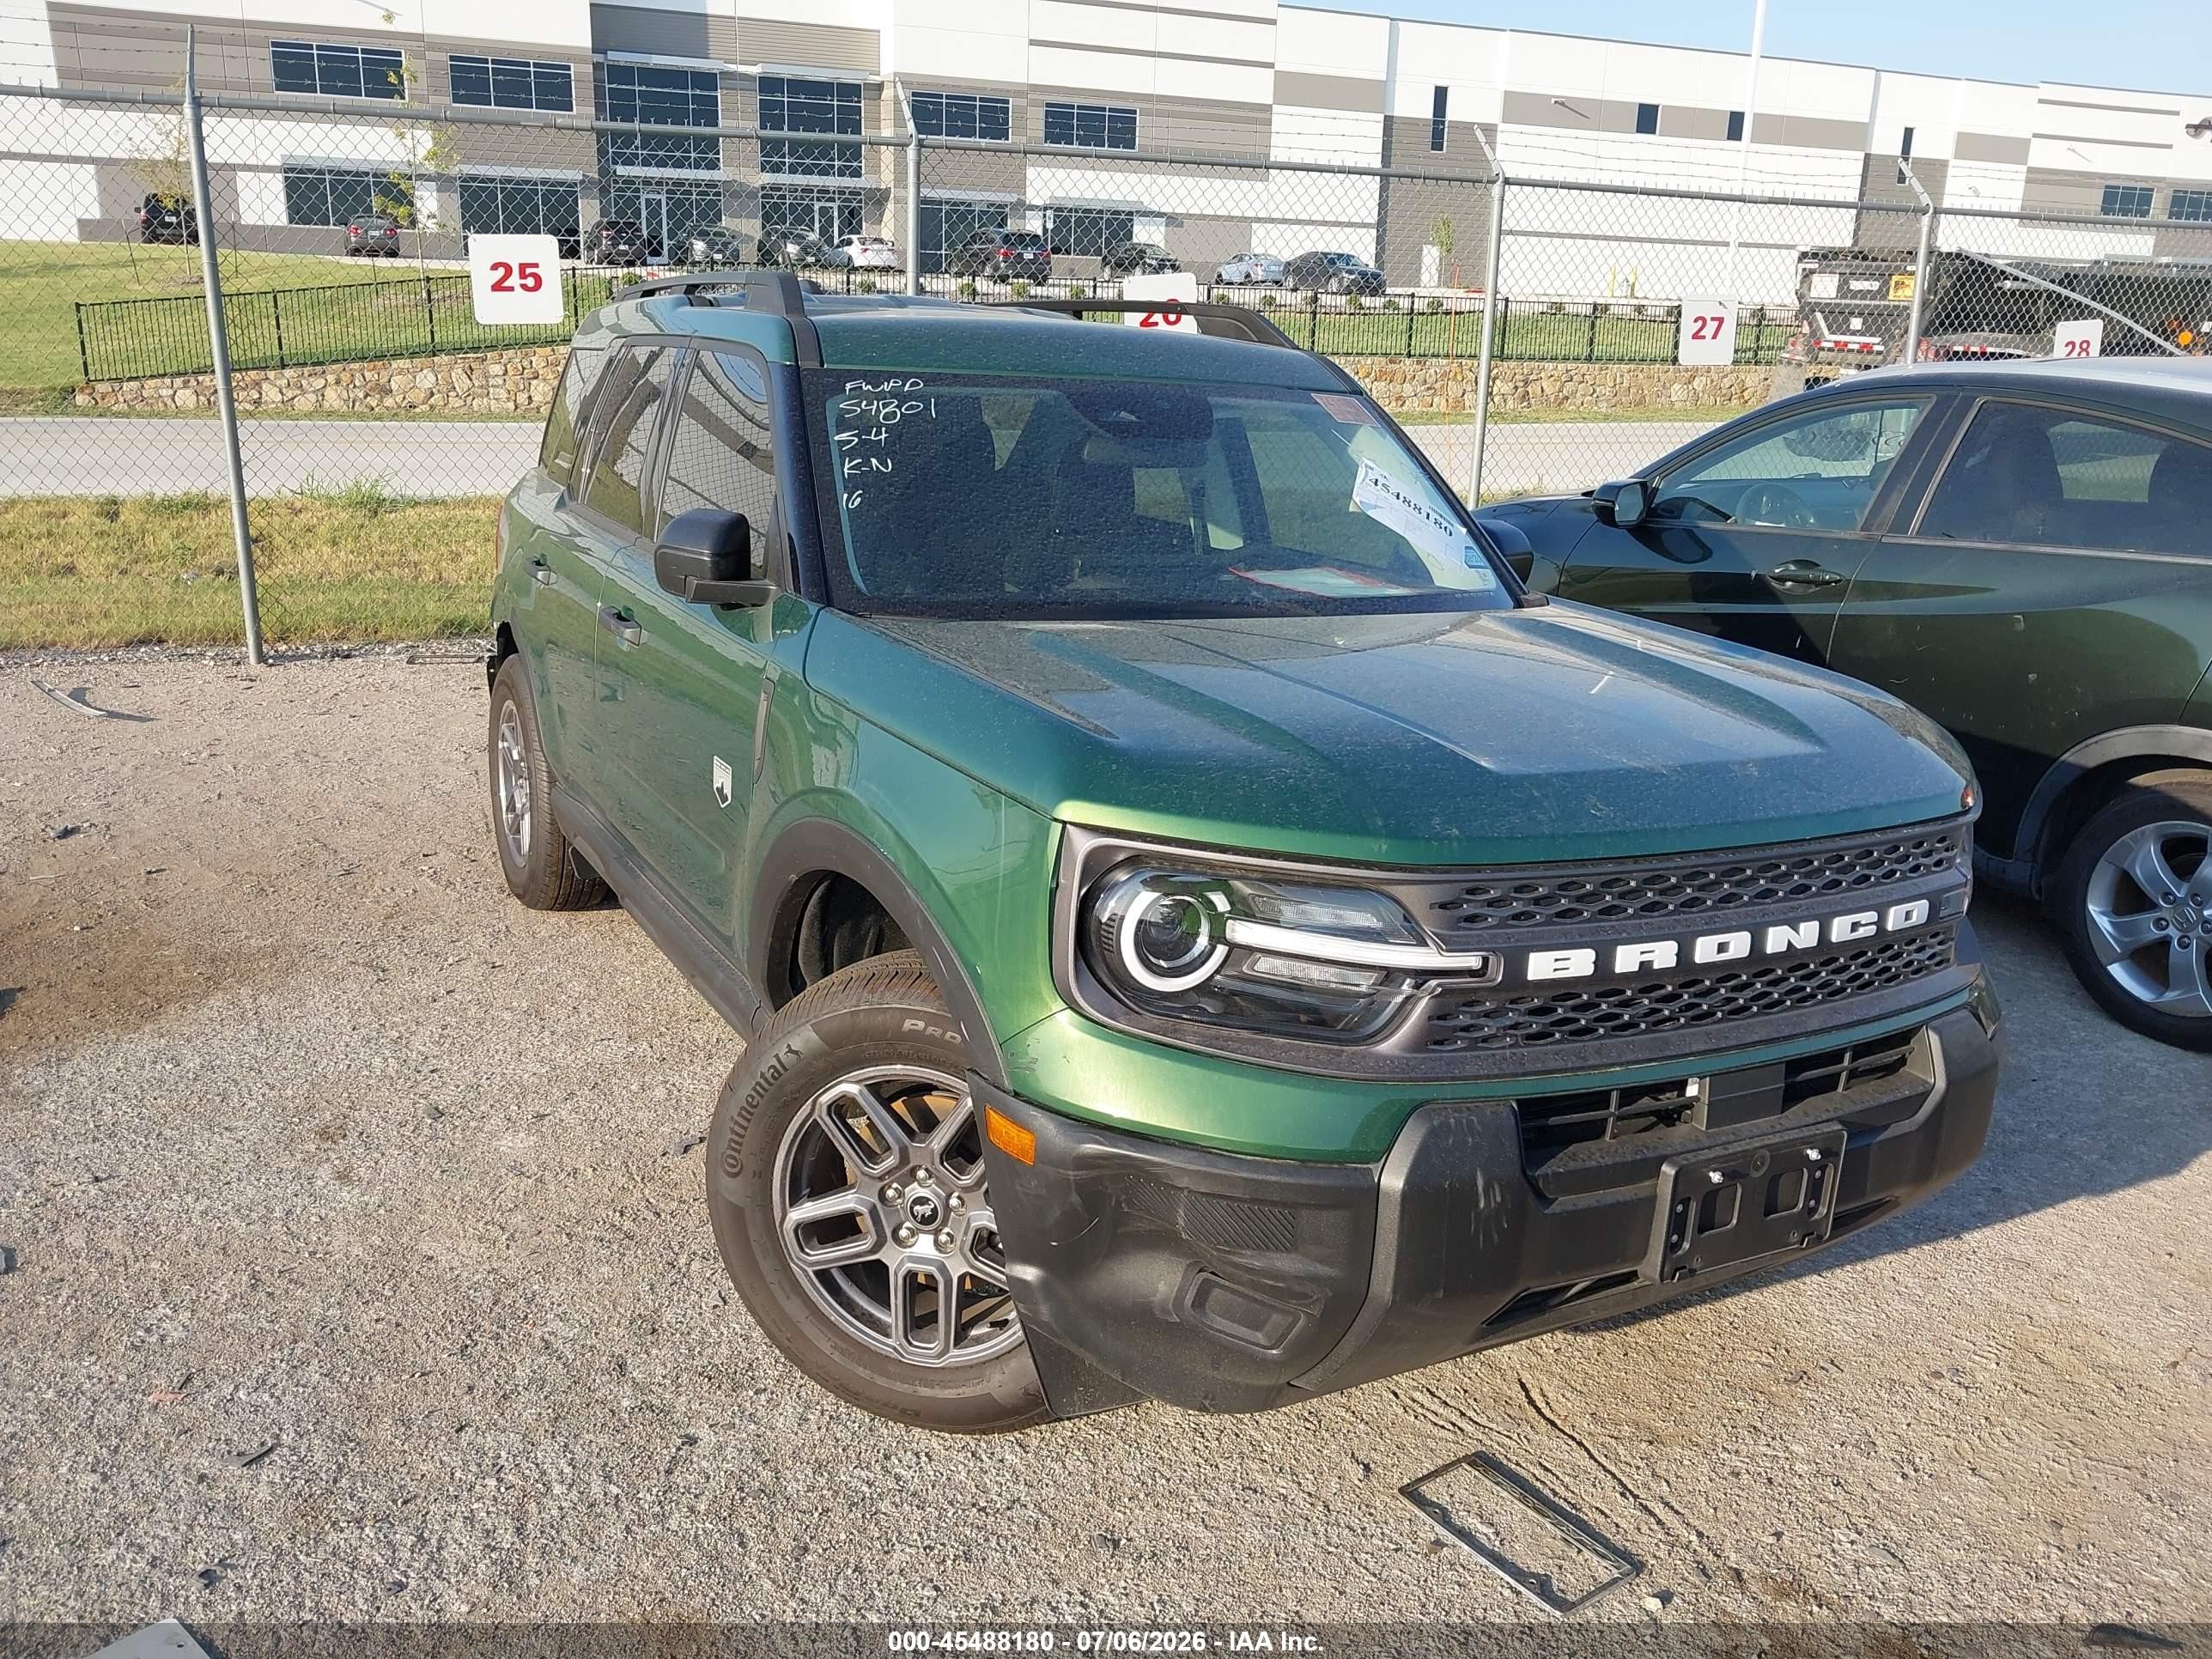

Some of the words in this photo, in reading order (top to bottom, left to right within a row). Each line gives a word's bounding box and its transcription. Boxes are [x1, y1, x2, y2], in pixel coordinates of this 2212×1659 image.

[489, 261, 543, 293] 25
[1691, 315, 1725, 340] 27
[2063, 339, 2091, 357] 28
[1368, 477, 1454, 538] 45488180
[1526, 898, 1930, 981] BRONCO
[720, 1053, 789, 1179] Continental
